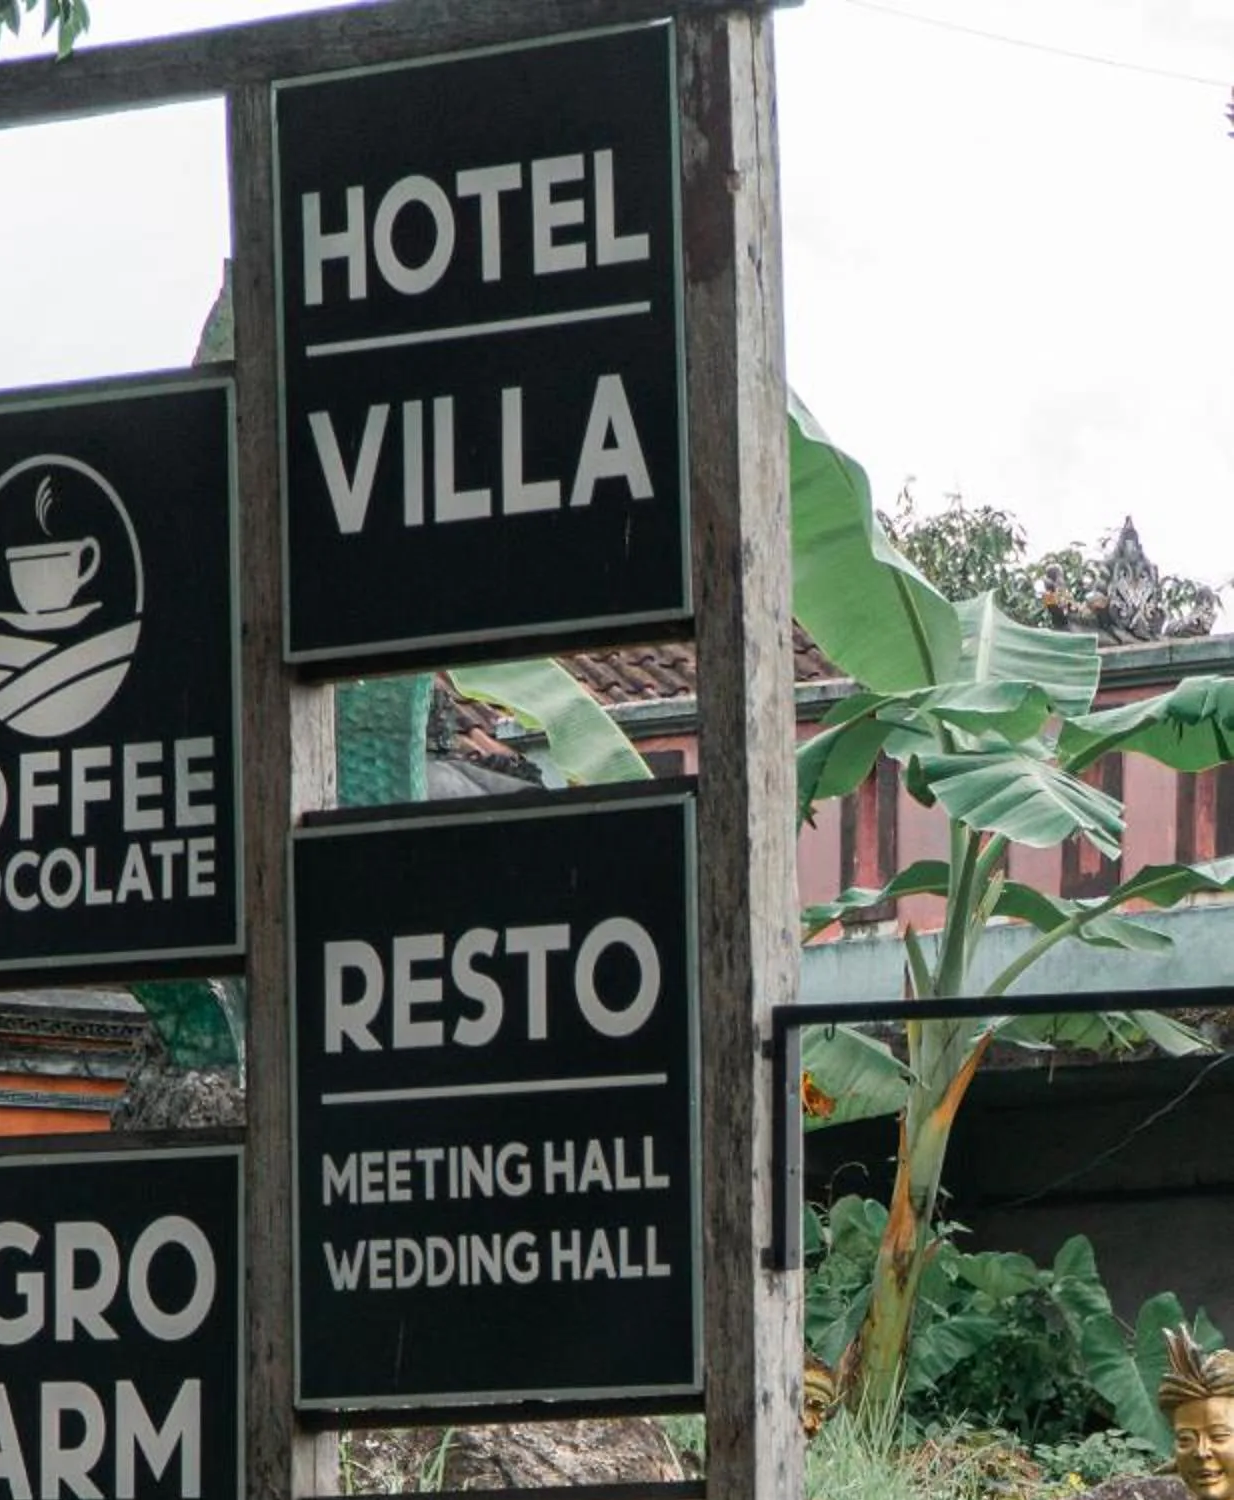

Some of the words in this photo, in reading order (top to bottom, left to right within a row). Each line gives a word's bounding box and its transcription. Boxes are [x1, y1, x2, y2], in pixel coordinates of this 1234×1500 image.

[299, 149, 651, 307] HOTEL
[307, 373, 655, 535] VILLA
[323, 916, 662, 1055] RESTO
[321, 1144, 533, 1206] MEETING
[544, 1135, 671, 1193] HALL
[322, 1232, 539, 1292] WEDDING
[551, 1226, 672, 1282] HALL
